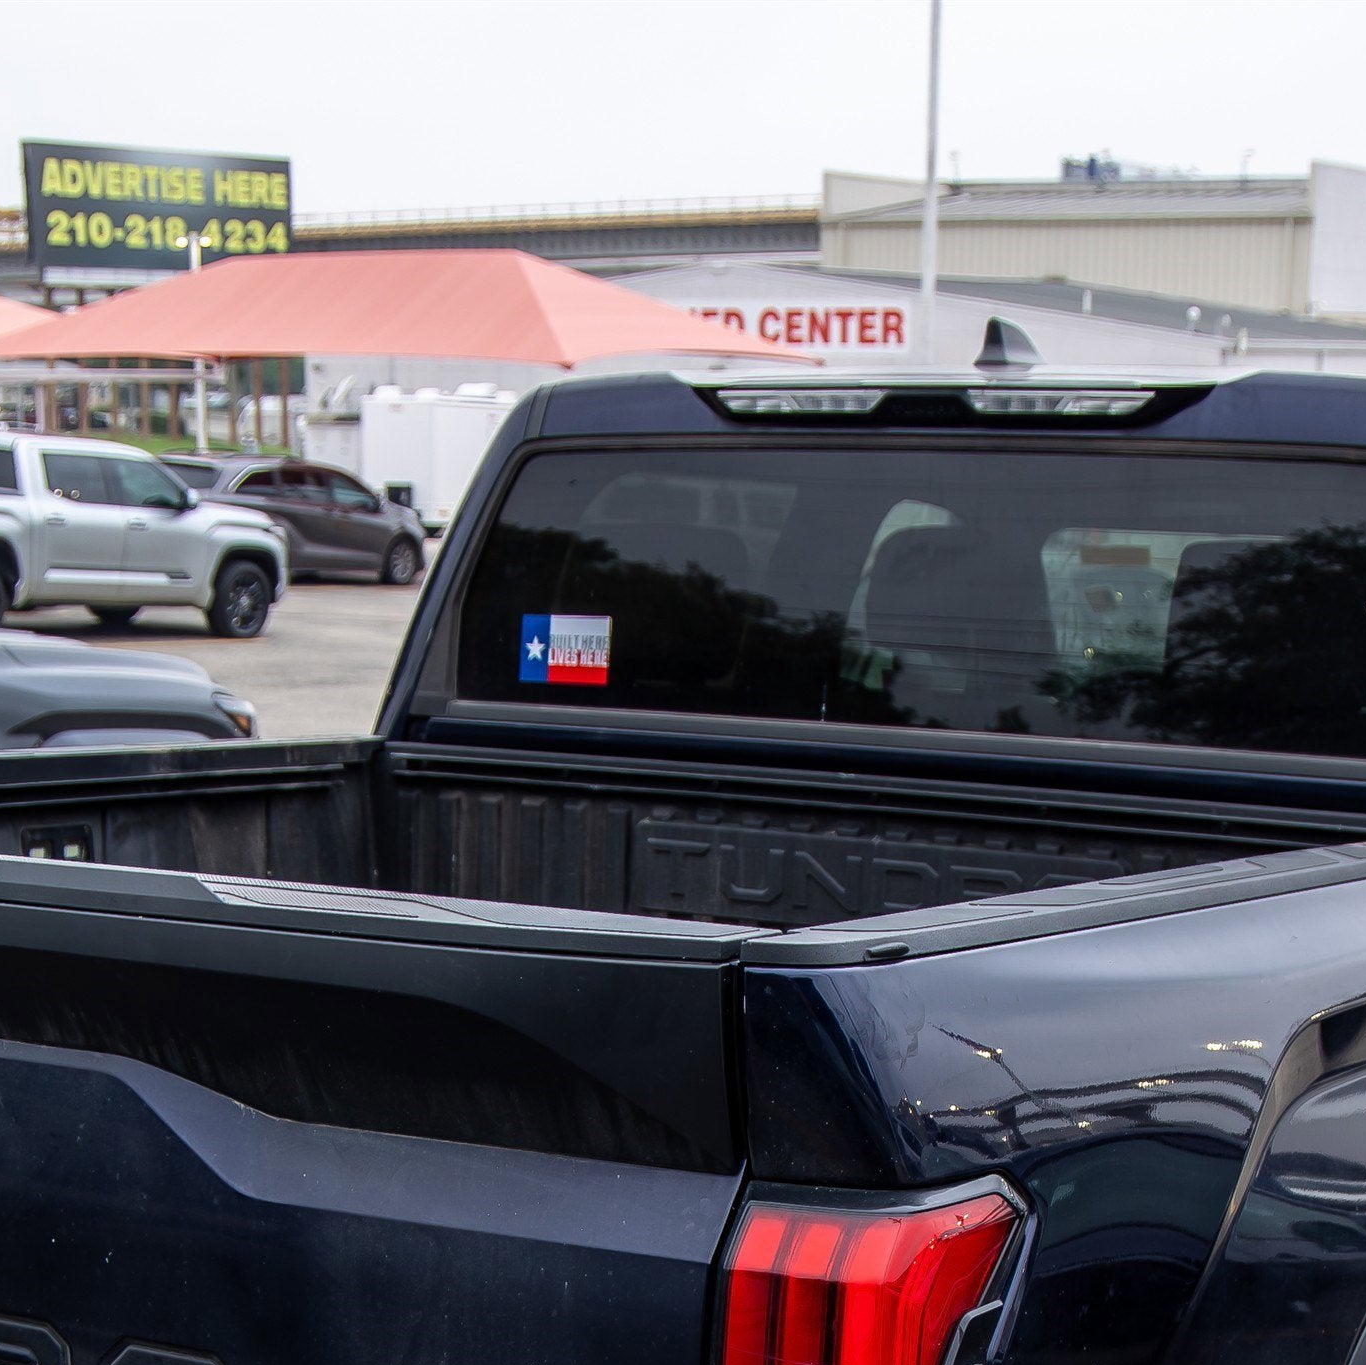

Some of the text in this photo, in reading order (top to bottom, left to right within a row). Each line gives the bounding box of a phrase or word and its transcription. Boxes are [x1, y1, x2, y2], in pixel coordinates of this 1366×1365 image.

[41, 157, 288, 210] ADVERTISE HERE
[46, 209, 290, 254] 210-2184234
[758, 305, 905, 345] CENTER
[548, 648, 610, 668] LIVES HERE
[549, 633, 611, 650] BUILT HERE
